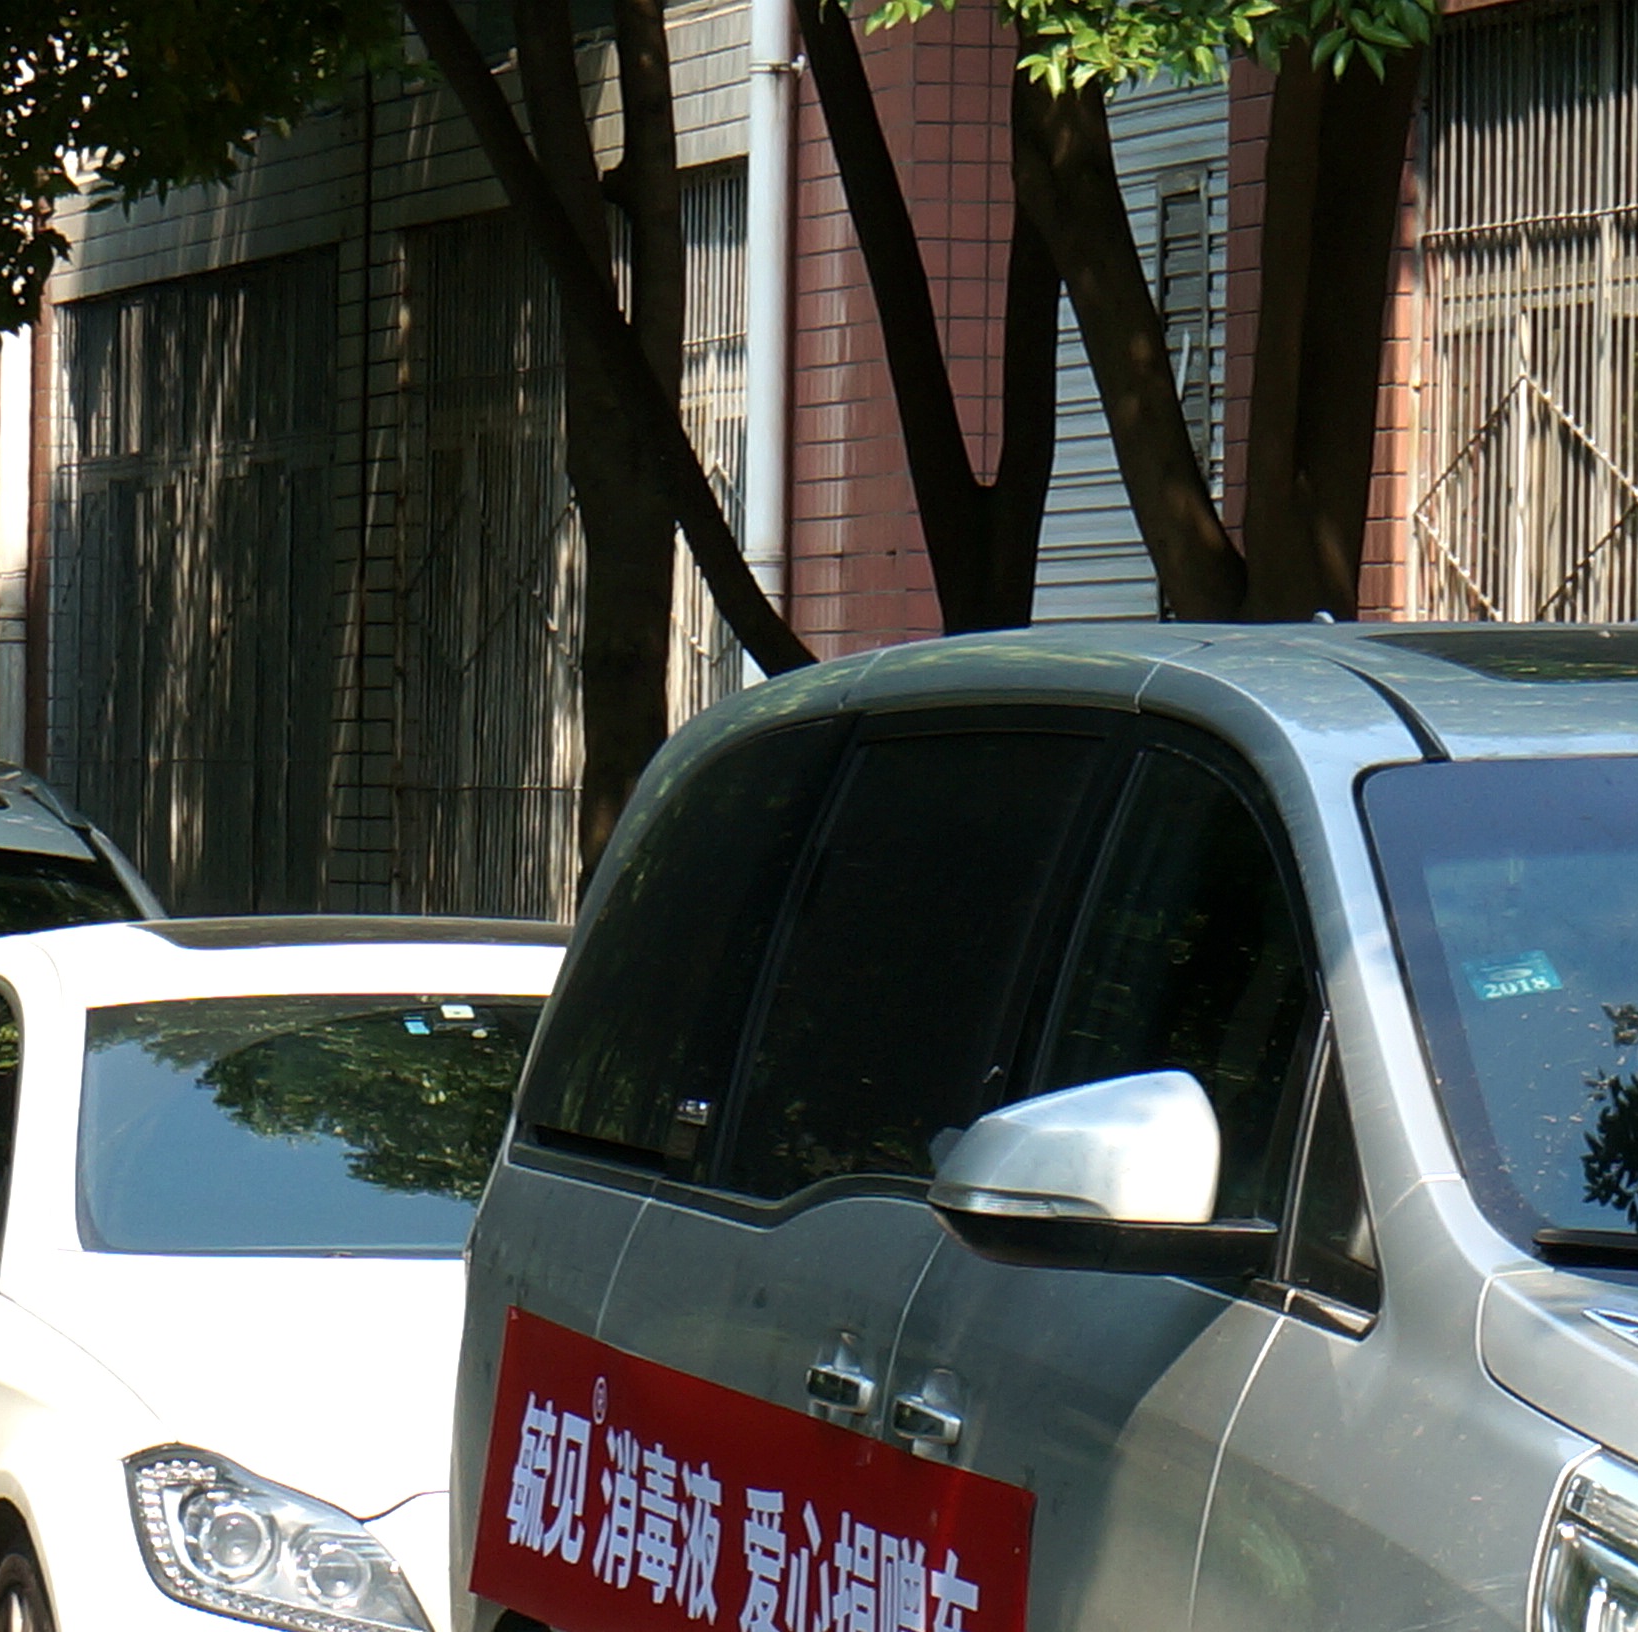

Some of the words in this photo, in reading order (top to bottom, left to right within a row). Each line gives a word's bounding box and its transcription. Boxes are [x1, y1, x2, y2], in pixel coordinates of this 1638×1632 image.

[1483, 976, 1551, 999] 2018
[593, 1427, 721, 1625] 消毒液
